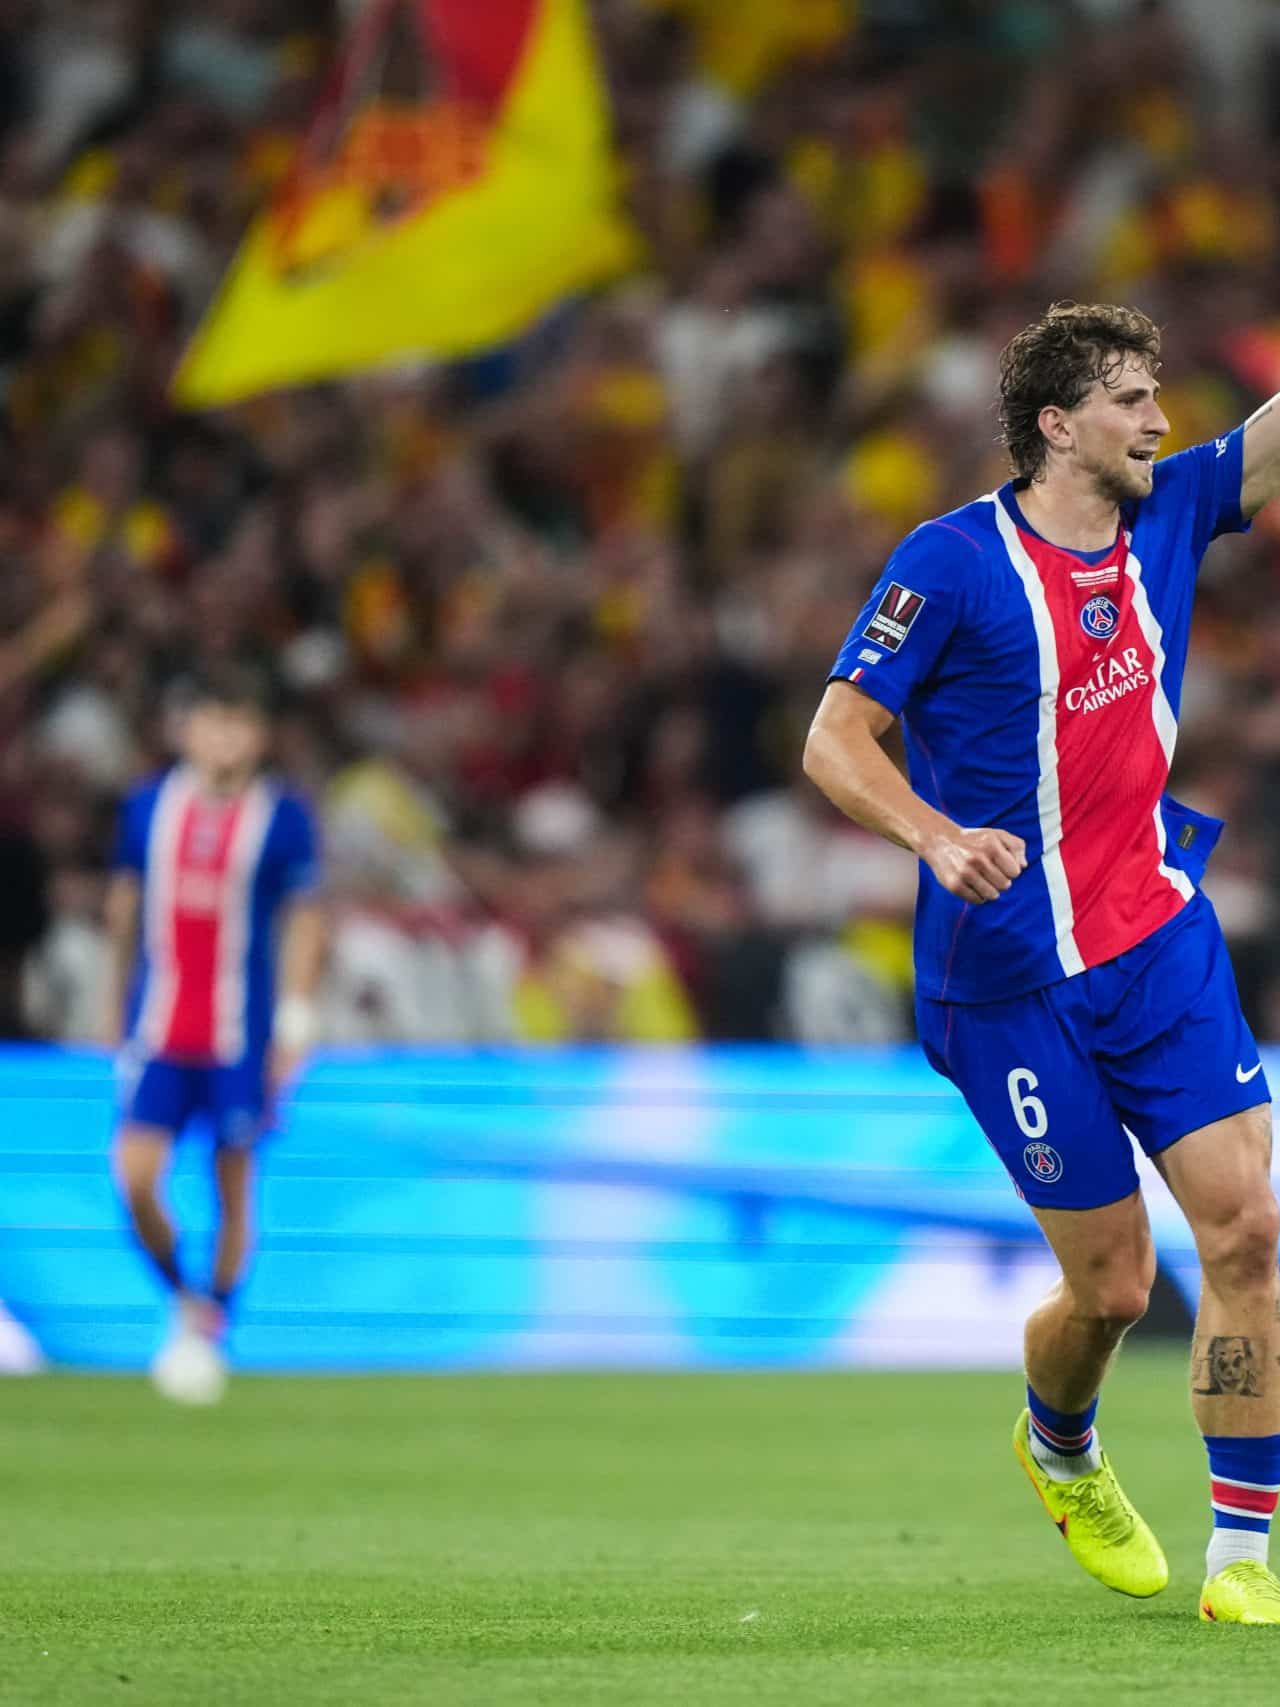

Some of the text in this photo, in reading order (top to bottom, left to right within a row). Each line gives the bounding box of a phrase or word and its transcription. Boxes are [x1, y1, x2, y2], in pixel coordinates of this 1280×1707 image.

[1065, 647, 1143, 711] QATAR
[1083, 670, 1149, 715] AIRWAYS
[1007, 1067, 1048, 1138] 6
